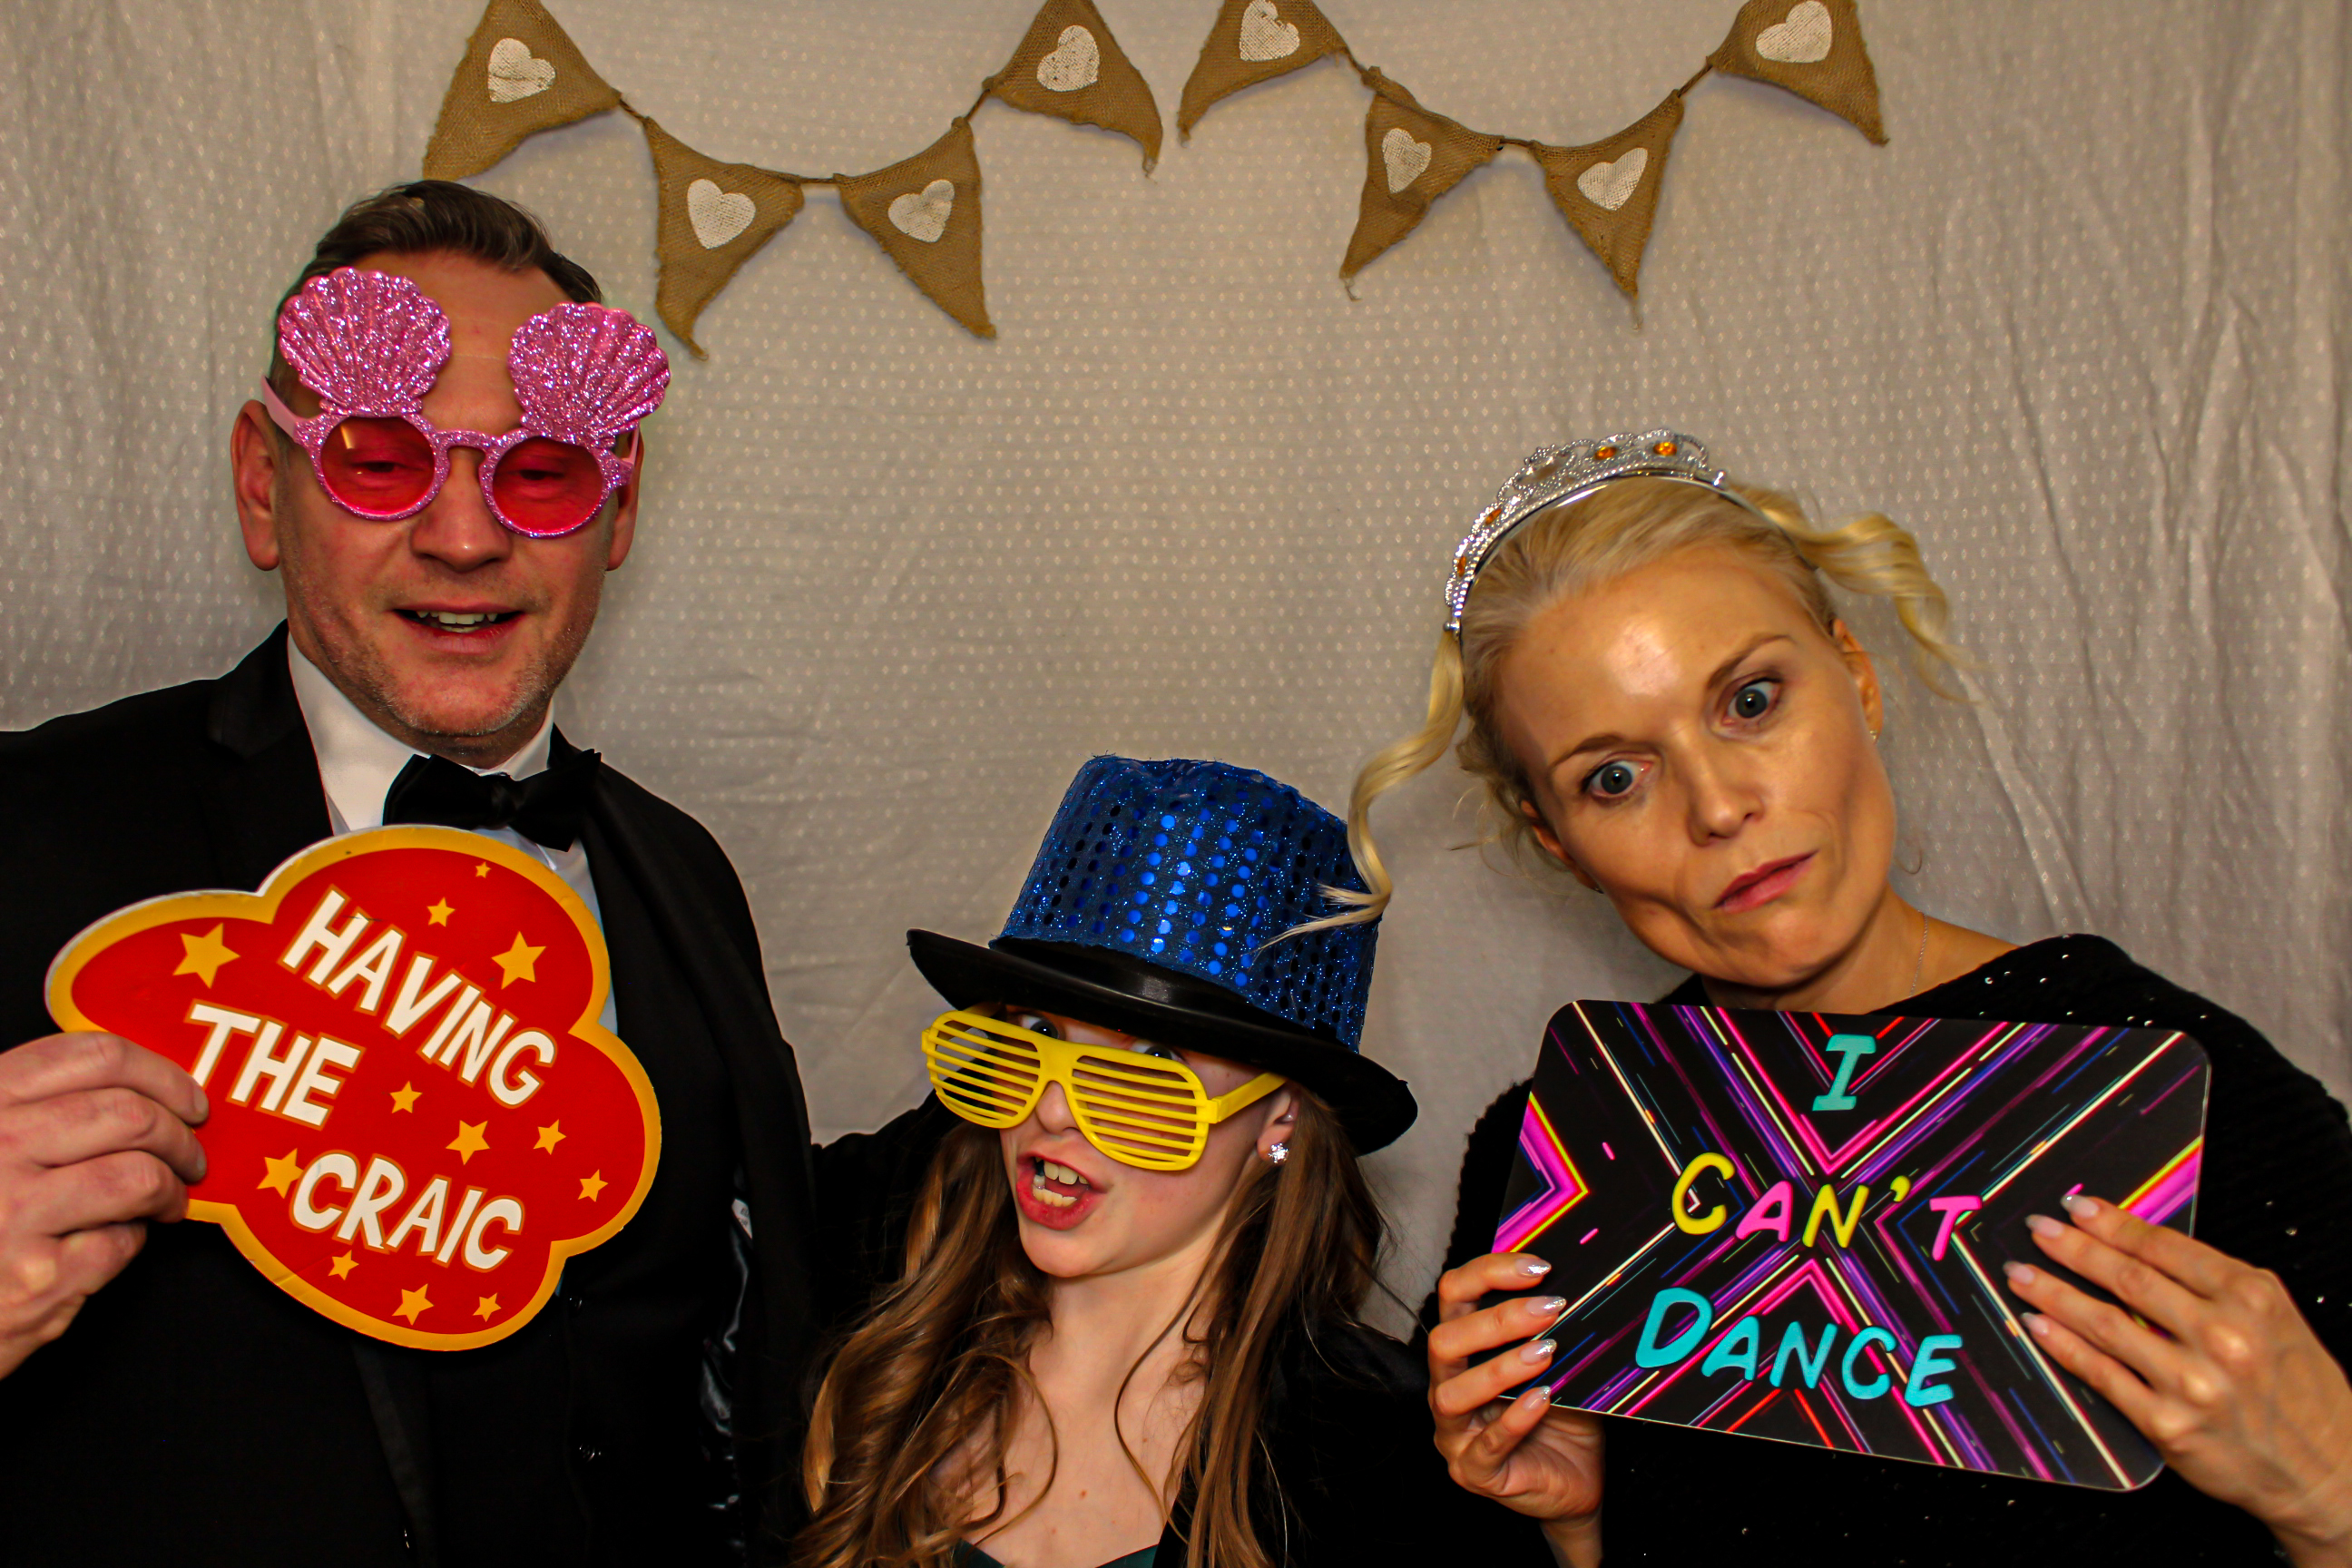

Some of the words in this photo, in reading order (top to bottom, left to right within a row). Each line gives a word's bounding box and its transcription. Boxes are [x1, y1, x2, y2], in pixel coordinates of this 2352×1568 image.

[279, 887, 556, 1108] HAVING
[187, 1002, 363, 1128] THE
[1812, 1034, 1877, 1112] I
[292, 1152, 524, 1271] CRAIC
[1671, 1152, 1982, 1261] CAN'T
[1634, 1287, 1962, 1407] DANCE
